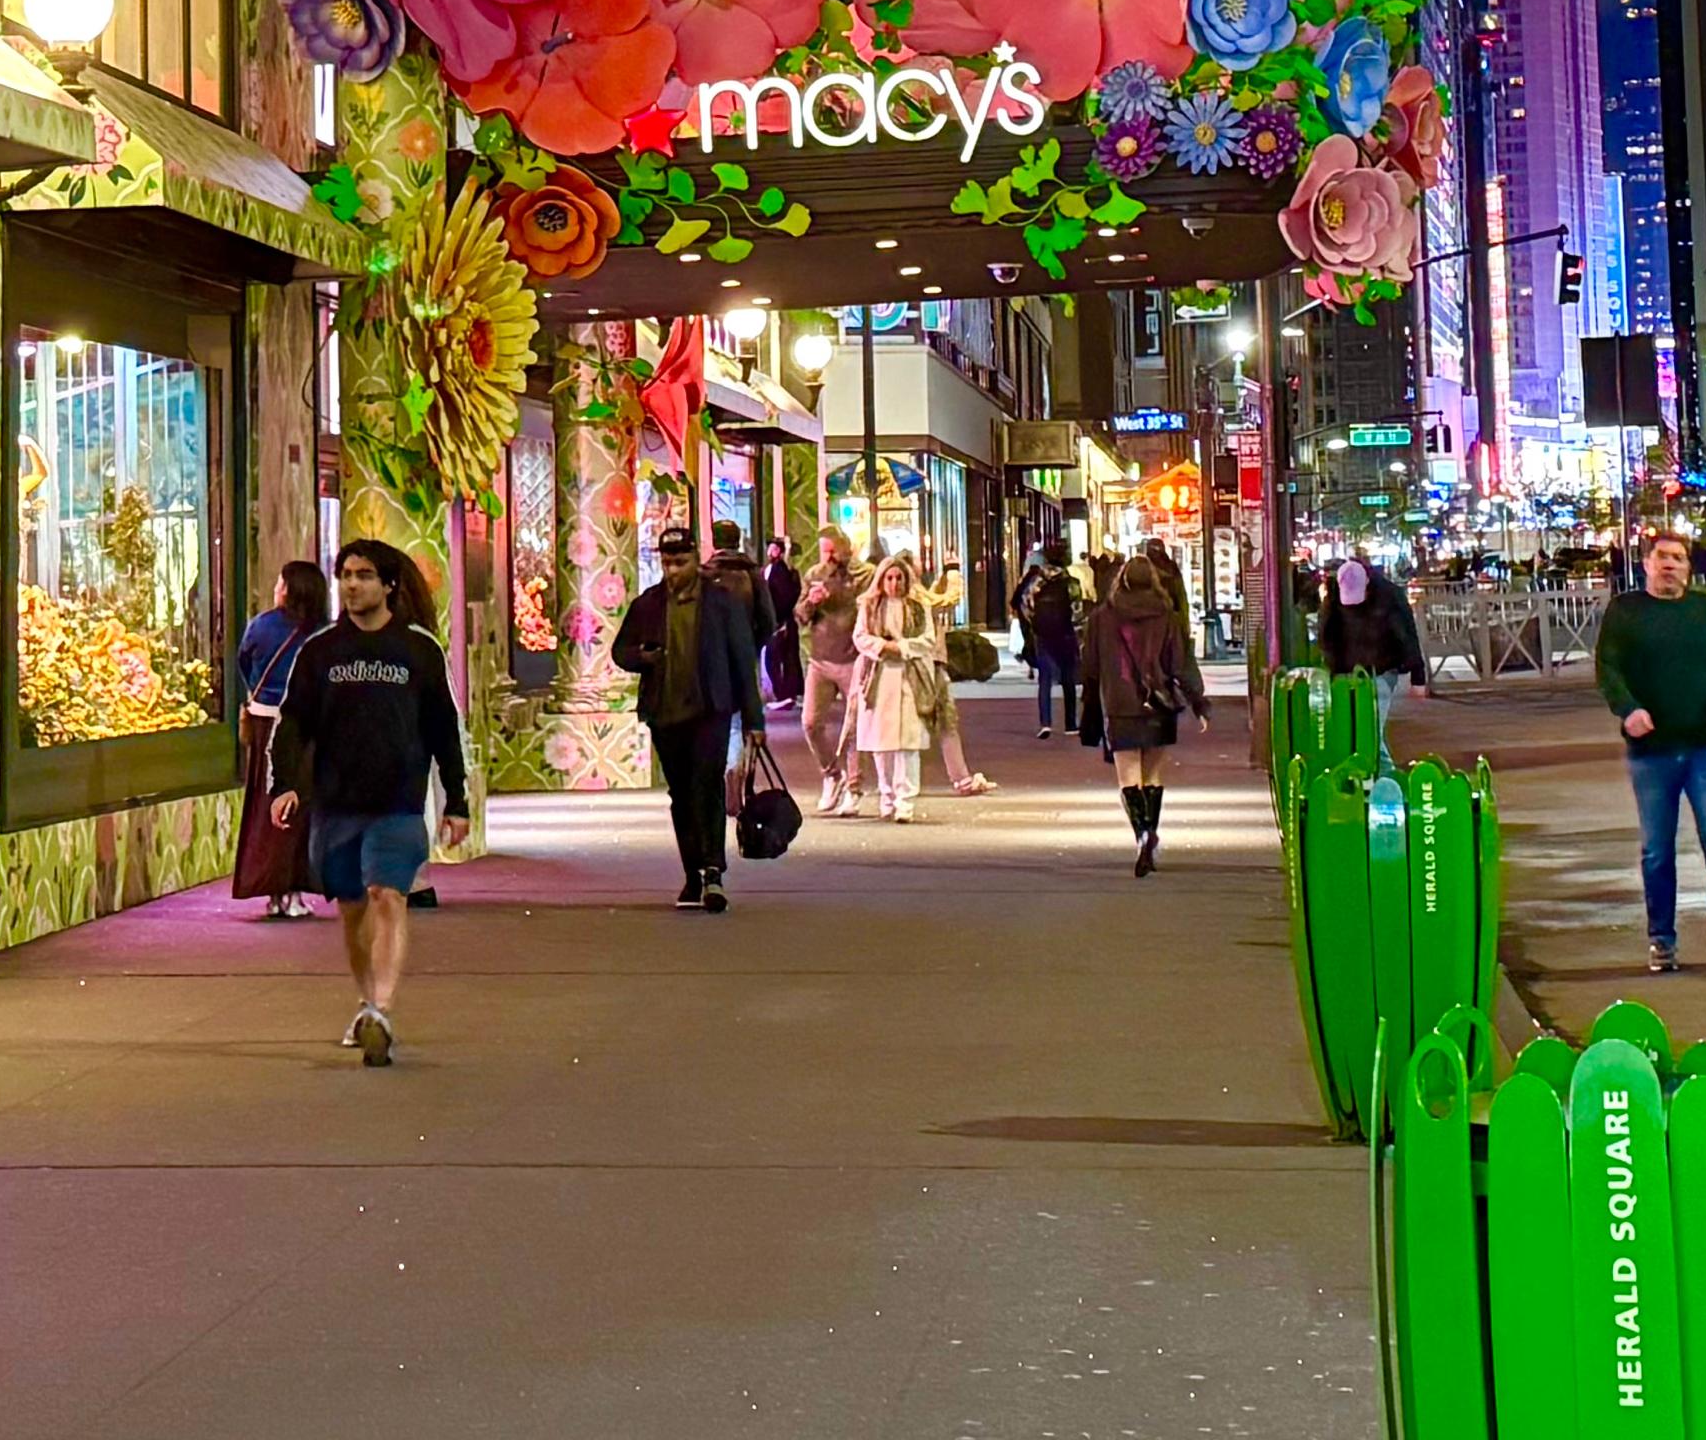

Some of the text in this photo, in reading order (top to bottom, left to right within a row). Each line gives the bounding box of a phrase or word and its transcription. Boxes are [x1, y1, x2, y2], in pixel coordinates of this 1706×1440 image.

[1114, 416, 1145, 431] West
[1170, 414, 1183, 429] St
[1421, 782, 1437, 913] HERALD SQUARE
[1603, 1090, 1645, 1408] HERALD SQUARE
